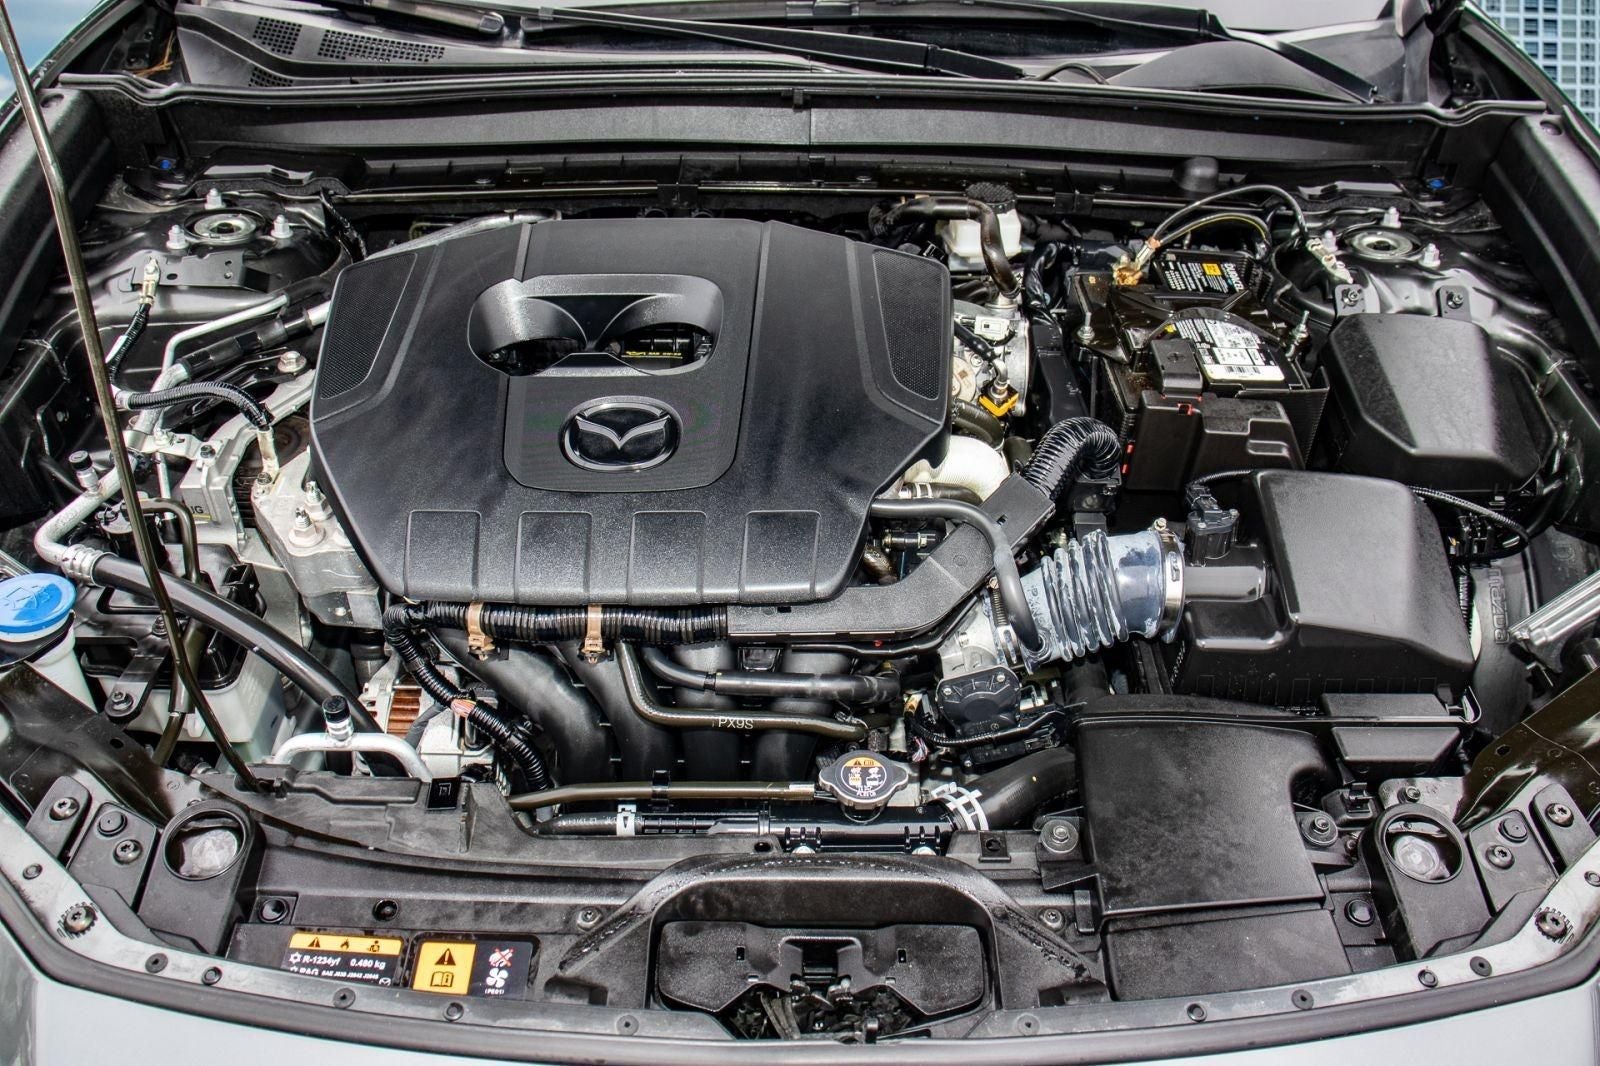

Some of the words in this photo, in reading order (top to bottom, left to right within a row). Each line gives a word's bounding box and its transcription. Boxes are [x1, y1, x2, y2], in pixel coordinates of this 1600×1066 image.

[718, 716, 754, 730] PX9S
[302, 954, 341, 968] R-1234yf
[350, 958, 374, 969] 0.480
[374, 960, 387, 971] kg
